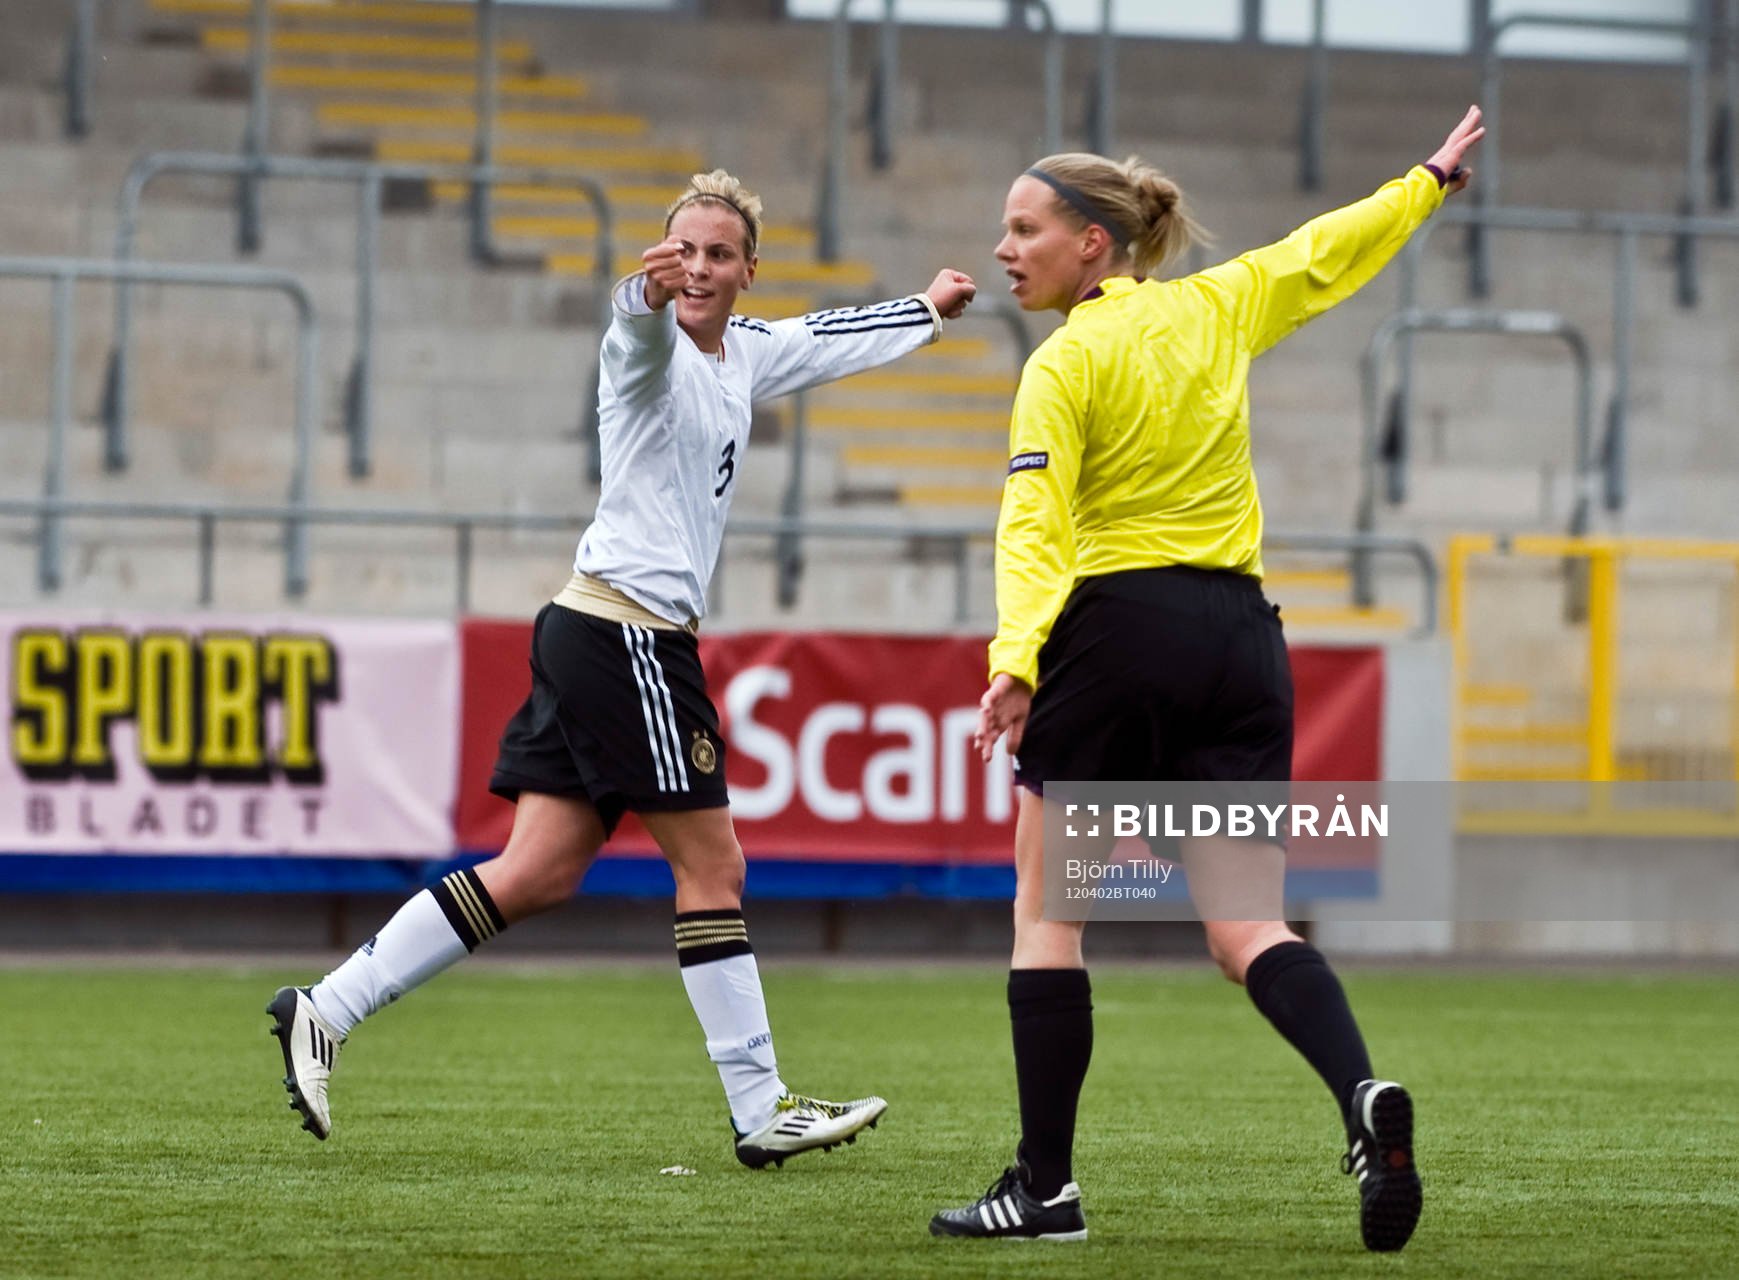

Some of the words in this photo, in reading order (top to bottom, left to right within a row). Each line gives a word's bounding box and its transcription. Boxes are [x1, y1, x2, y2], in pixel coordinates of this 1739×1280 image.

[714, 439, 736, 498] 3
[12, 629, 341, 783] SPORT
[724, 665, 1022, 824] Scan
[26, 798, 327, 838] BLADET
